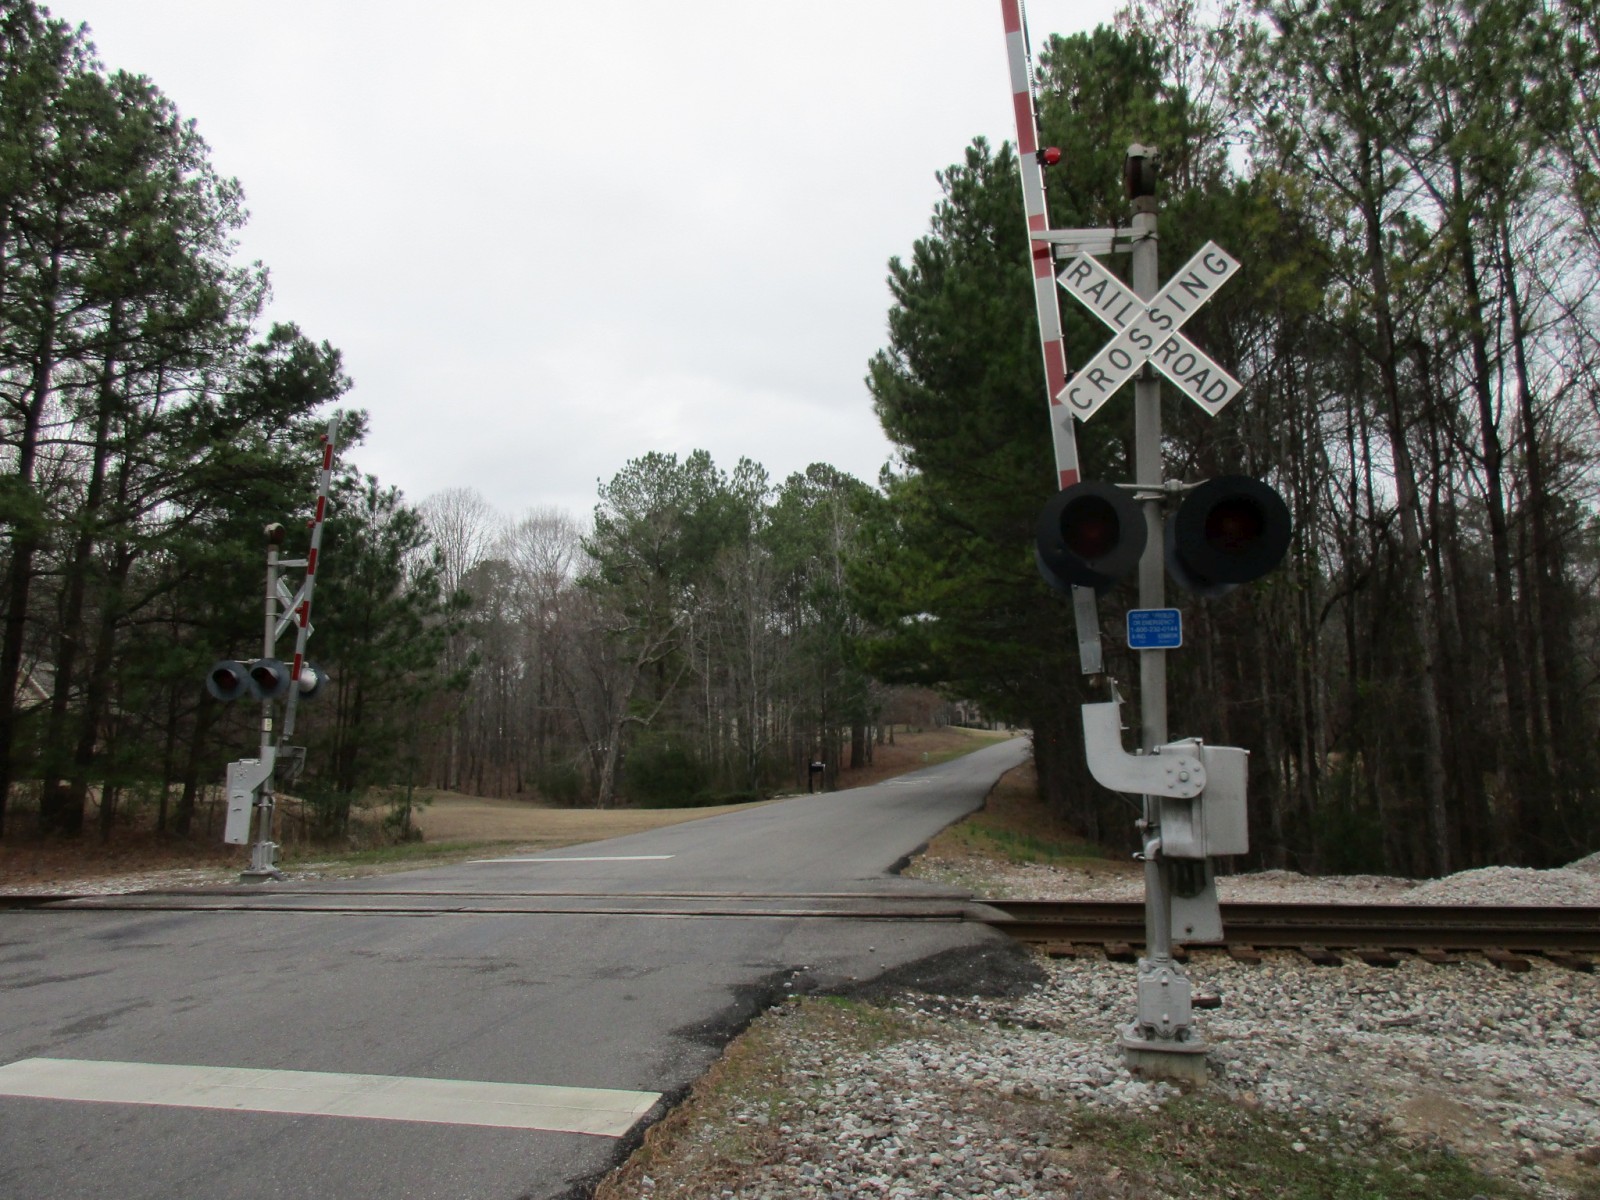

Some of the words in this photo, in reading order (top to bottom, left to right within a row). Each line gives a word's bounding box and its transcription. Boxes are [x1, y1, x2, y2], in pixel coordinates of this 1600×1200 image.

[1066, 260, 1133, 329] RAIL
[1153, 337, 1228, 404] ROAD
[1068, 252, 1229, 411] CROSSING
